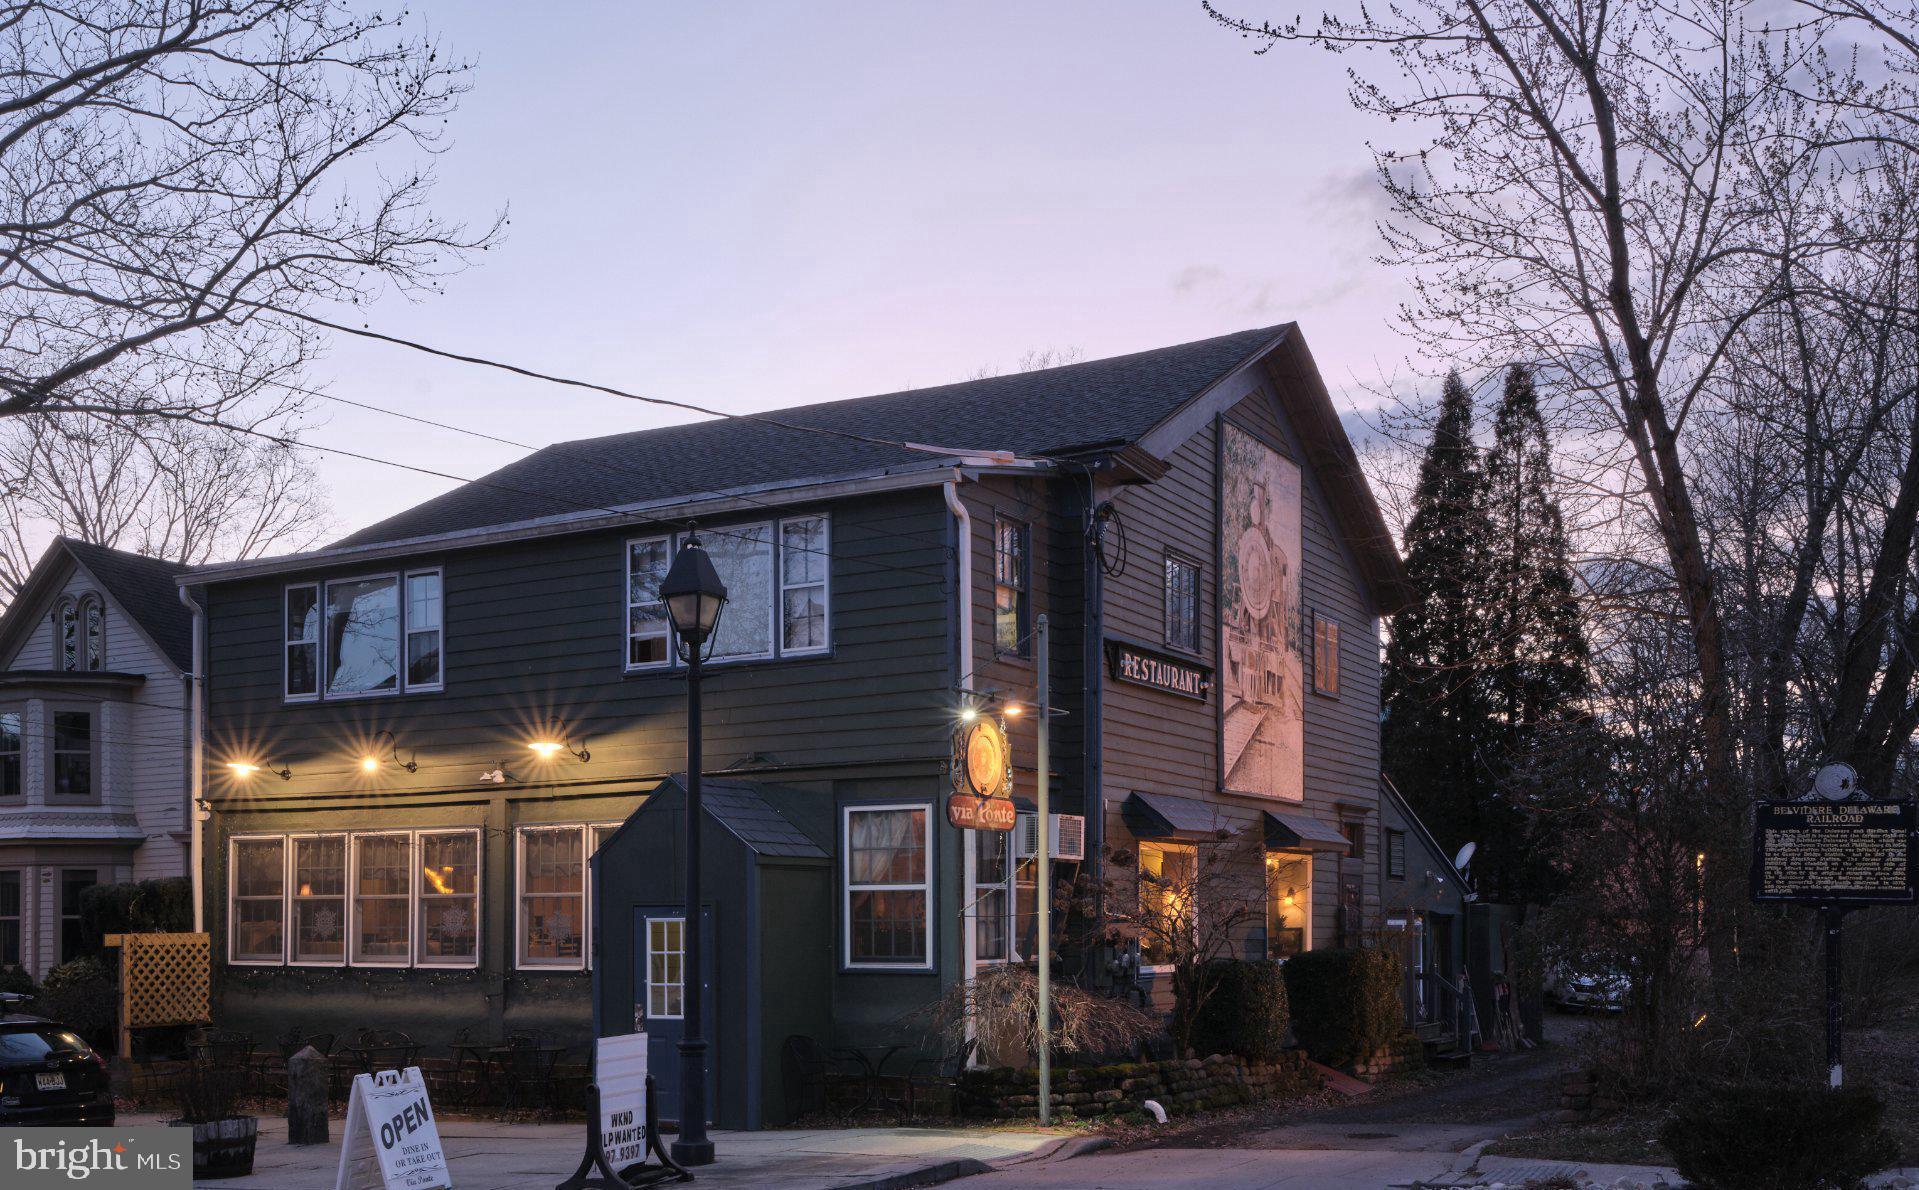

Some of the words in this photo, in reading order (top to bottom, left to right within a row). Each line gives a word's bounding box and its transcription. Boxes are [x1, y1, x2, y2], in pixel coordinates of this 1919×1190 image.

[1124, 653, 1200, 694] RESTAURANT
[1774, 806, 1833, 815] BELVIDERE
[1839, 805, 1900, 815] DELAWARE
[1807, 814, 1864, 823] RAILROAD
[381, 1097, 429, 1149] OPEN
[612, 1111, 633, 1128] WKND
[402, 1145, 420, 1155] DINE
[420, 1142, 430, 1152] IN
[620, 1143, 641, 1161] 9397
[395, 1159, 406, 1168] OR
[406, 1154, 426, 1166] TAKE
[426, 1151, 441, 1162] OUT
